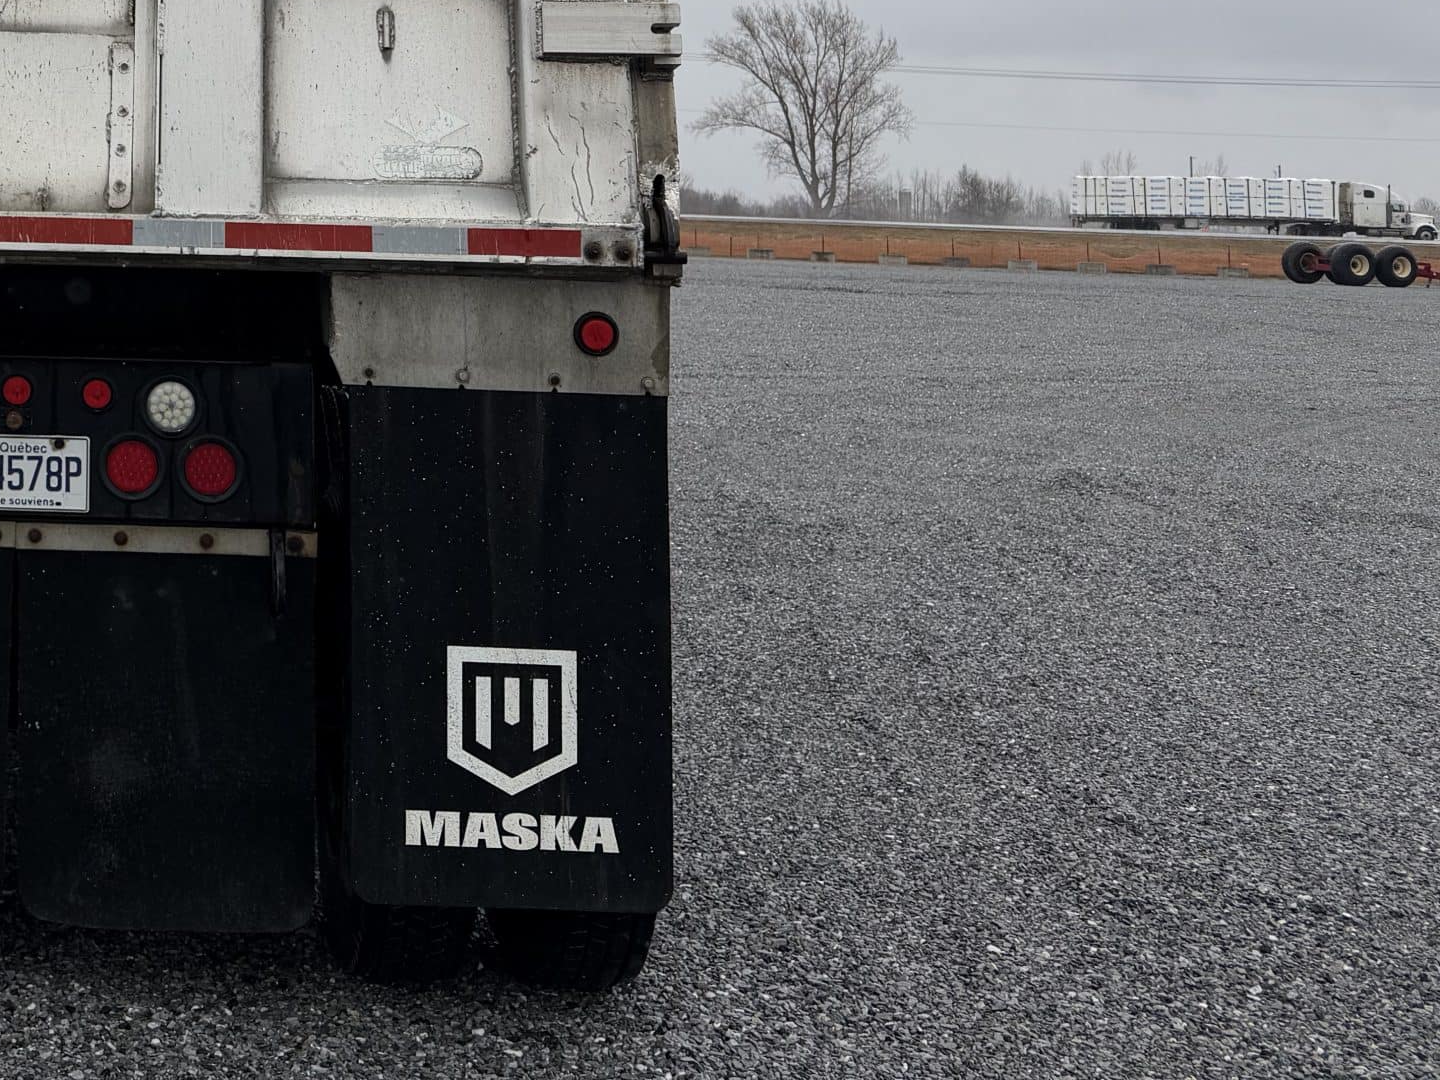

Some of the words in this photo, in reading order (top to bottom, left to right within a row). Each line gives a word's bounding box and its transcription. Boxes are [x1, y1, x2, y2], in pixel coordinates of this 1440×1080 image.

[0, 441, 47, 454] Québec
[9, 496, 55, 506] souviens
[404, 809, 620, 854] MASKA
